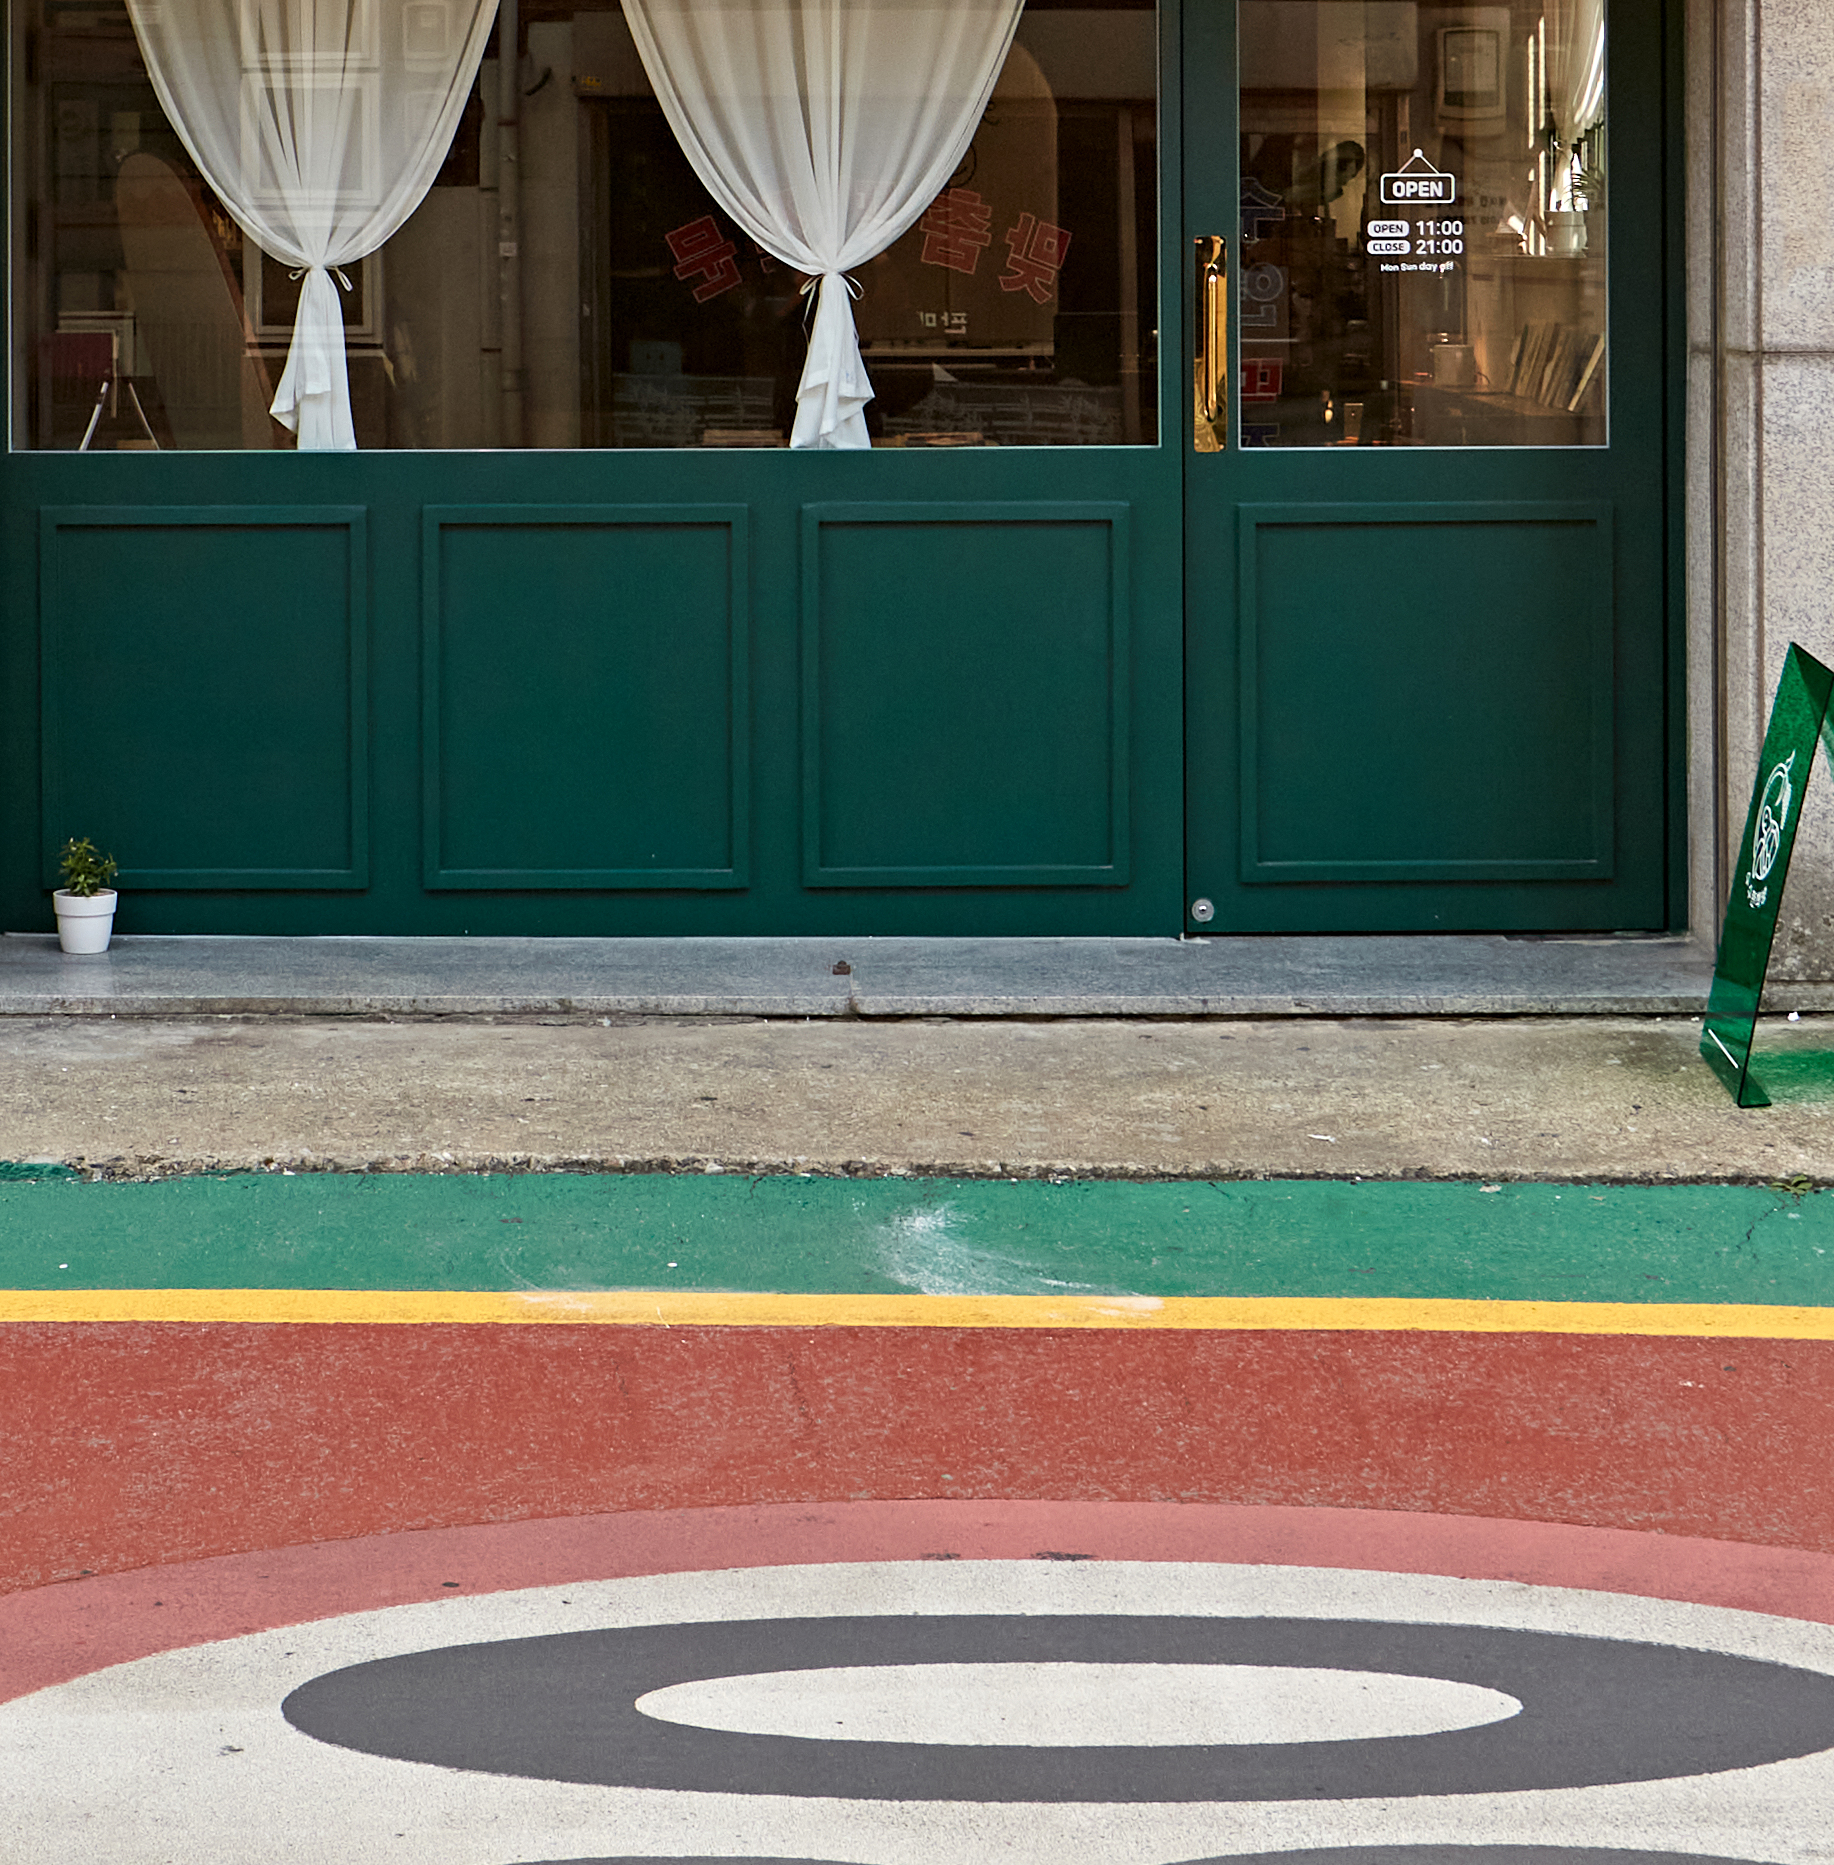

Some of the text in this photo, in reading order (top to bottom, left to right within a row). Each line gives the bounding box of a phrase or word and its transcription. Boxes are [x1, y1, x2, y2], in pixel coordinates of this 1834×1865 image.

[1392, 181, 1443, 198] OPEN
[1373, 224, 1404, 234] OPEN
[1415, 220, 1464, 236] 11:00
[1372, 239, 1464, 255] CLOSE 21:00
[1380, 263, 1399, 272] Mon
[1400, 263, 1417, 271] Sun
[1419, 261, 1438, 273] day
